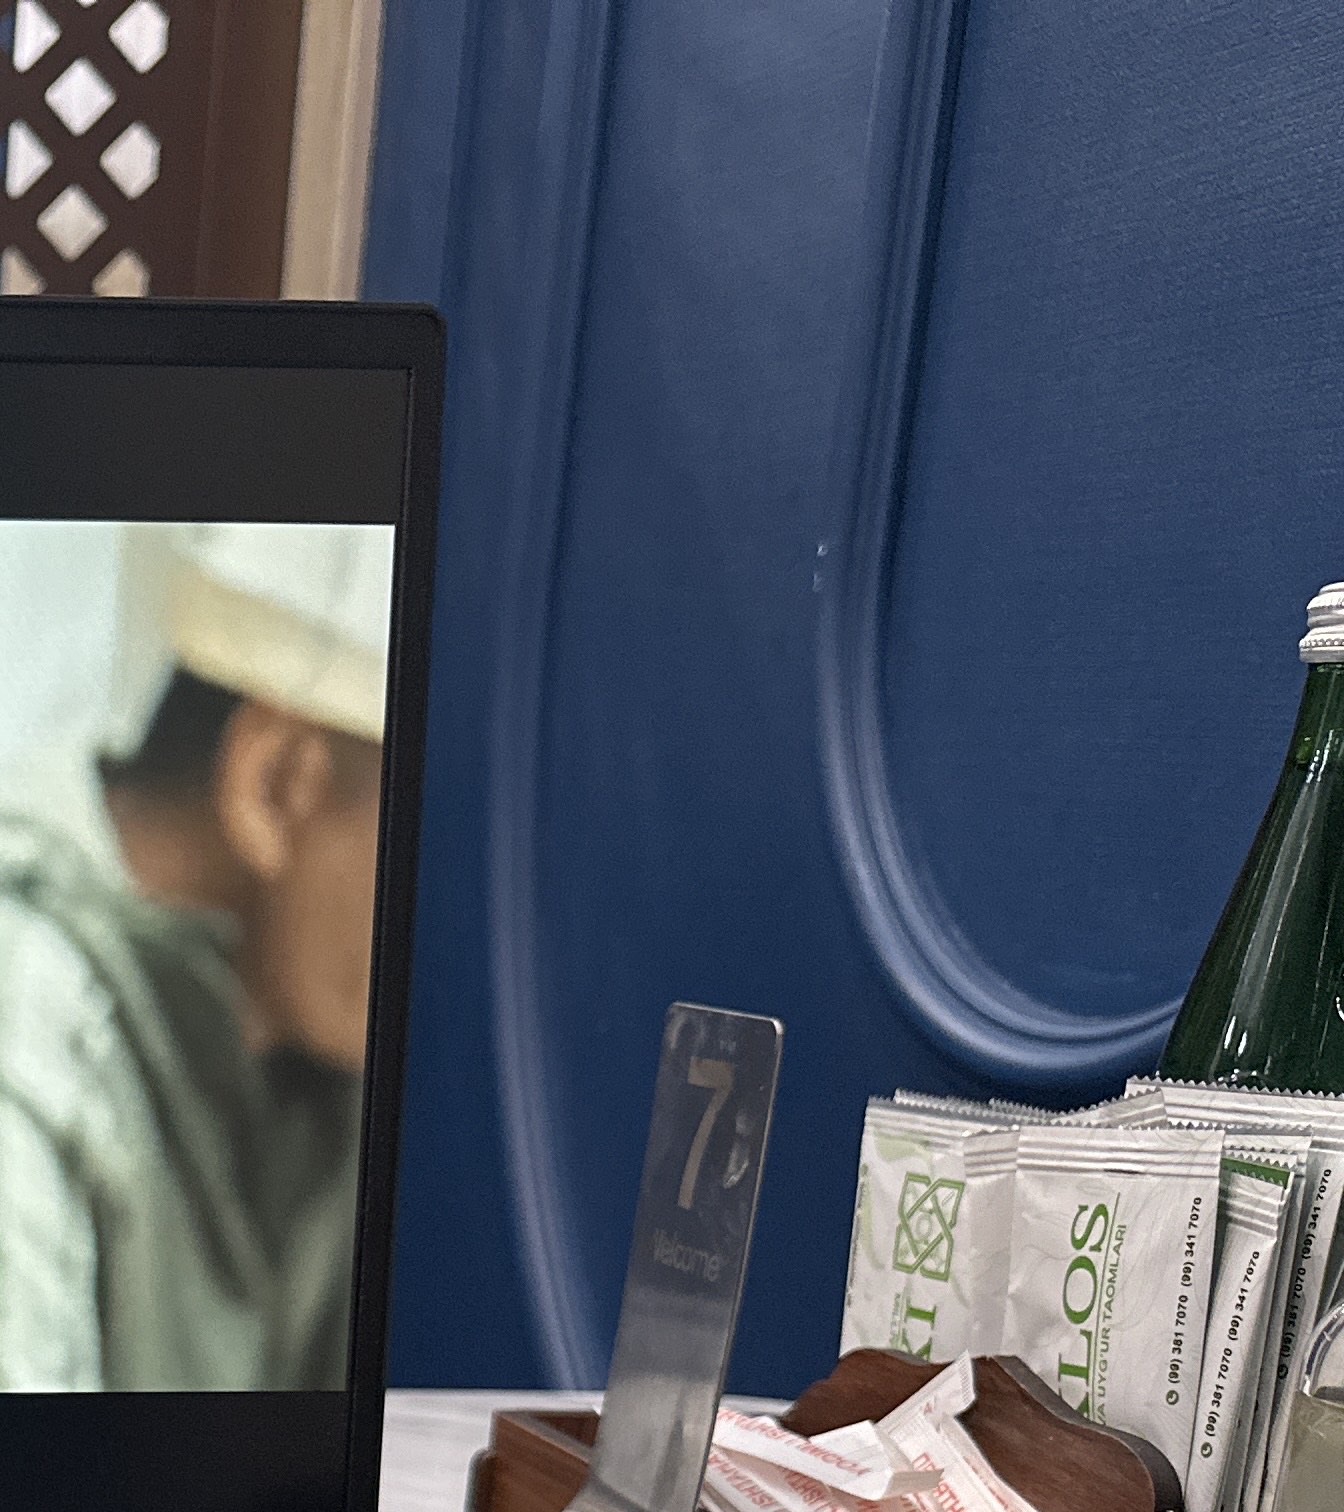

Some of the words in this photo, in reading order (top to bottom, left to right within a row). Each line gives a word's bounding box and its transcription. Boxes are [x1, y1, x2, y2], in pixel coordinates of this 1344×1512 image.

[678, 1056, 735, 1210] 7
[1188, 1197, 1202, 1229] 7070
[1185, 1234, 1197, 1257] 341
[1102, 1224, 1127, 1322] TAOMLARI
[1181, 1261, 1196, 1287] (99)
[1243, 1251, 1260, 1283] 7070
[1176, 1295, 1189, 1327] 7070
[1235, 1287, 1248, 1311] 341
[1227, 1315, 1244, 1341] (99)
[1172, 1331, 1185, 1355] 381
[1168, 1358, 1183, 1384] (99)
[1217, 1347, 1233, 1381] 7070
[1212, 1383, 1224, 1408] 381
[1204, 1411, 1220, 1437] (99)
